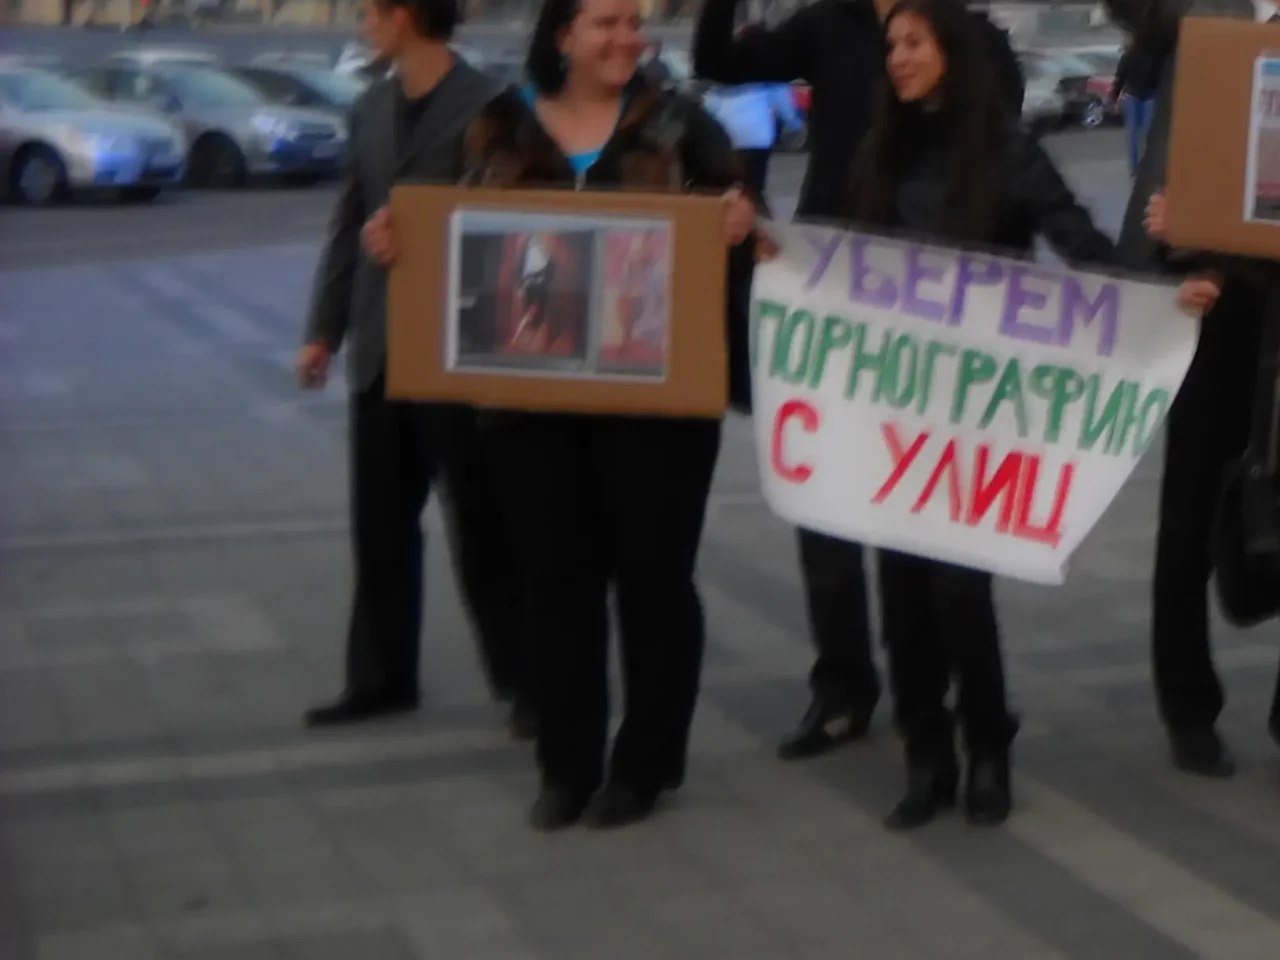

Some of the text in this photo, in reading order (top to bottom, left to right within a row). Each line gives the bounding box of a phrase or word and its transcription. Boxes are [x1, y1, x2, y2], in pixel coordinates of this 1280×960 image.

[801, 229, 1120, 357] УБЕРЕМ
[755, 298, 1171, 458] ПОРНОГРАФИЮ
[769, 398, 1077, 549] С УЛИЦ
